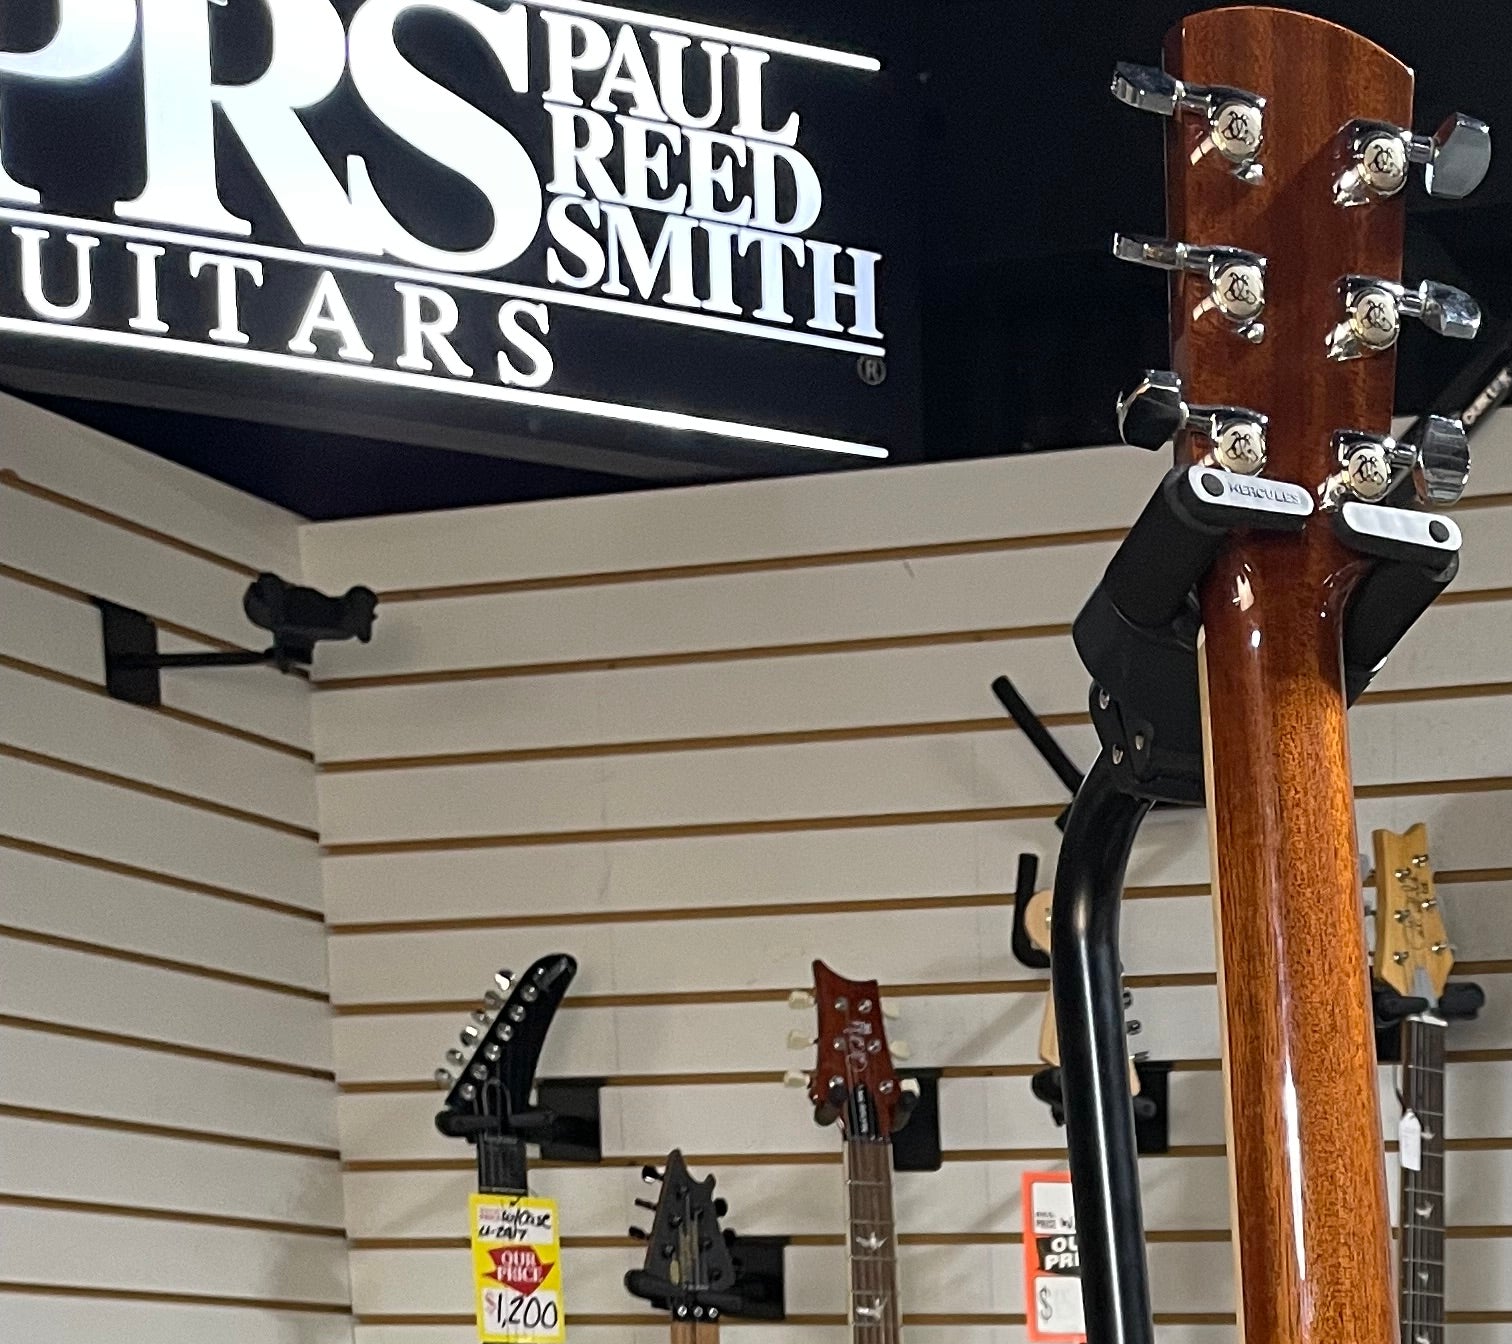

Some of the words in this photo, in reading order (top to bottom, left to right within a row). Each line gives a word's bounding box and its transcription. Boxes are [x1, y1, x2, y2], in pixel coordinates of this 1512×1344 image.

[540, 11, 800, 144] PAUL
[545, 102, 822, 236] REED
[548, 196, 884, 339] SMITH
[11, 227, 556, 388] UITARS
[1228, 481, 1300, 505] HERCULES
[1051, 1236, 1078, 1253] OU
[501, 1251, 536, 1266] OUR
[1044, 1253, 1079, 1270] PRI
[497, 1266, 543, 1283] PRICE
